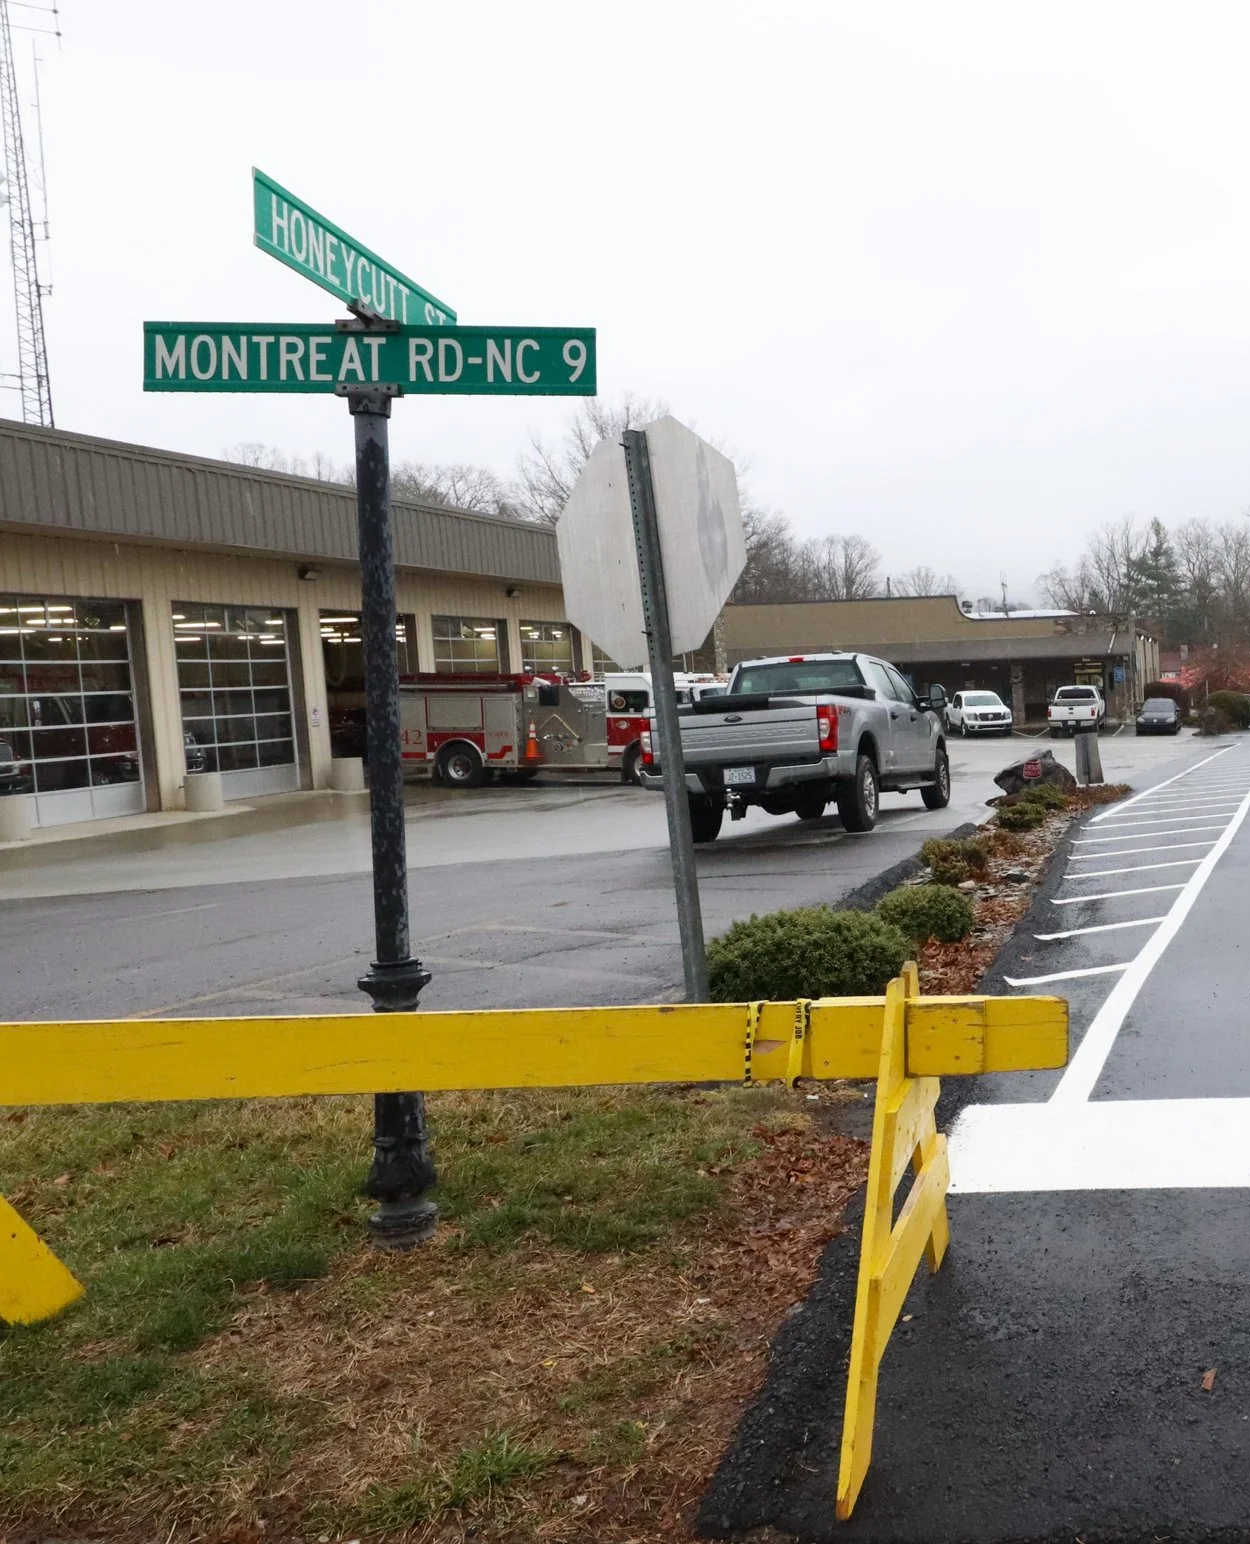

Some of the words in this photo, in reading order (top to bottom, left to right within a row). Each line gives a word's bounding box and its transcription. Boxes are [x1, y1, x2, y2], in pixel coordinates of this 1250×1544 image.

[270, 193, 410, 325] HONEYCUTT
[154, 334, 388, 382] MONTREAT
[408, 337, 541, 383] RD-NC
[562, 339, 588, 383] 9
[401, 729, 423, 745] 42
